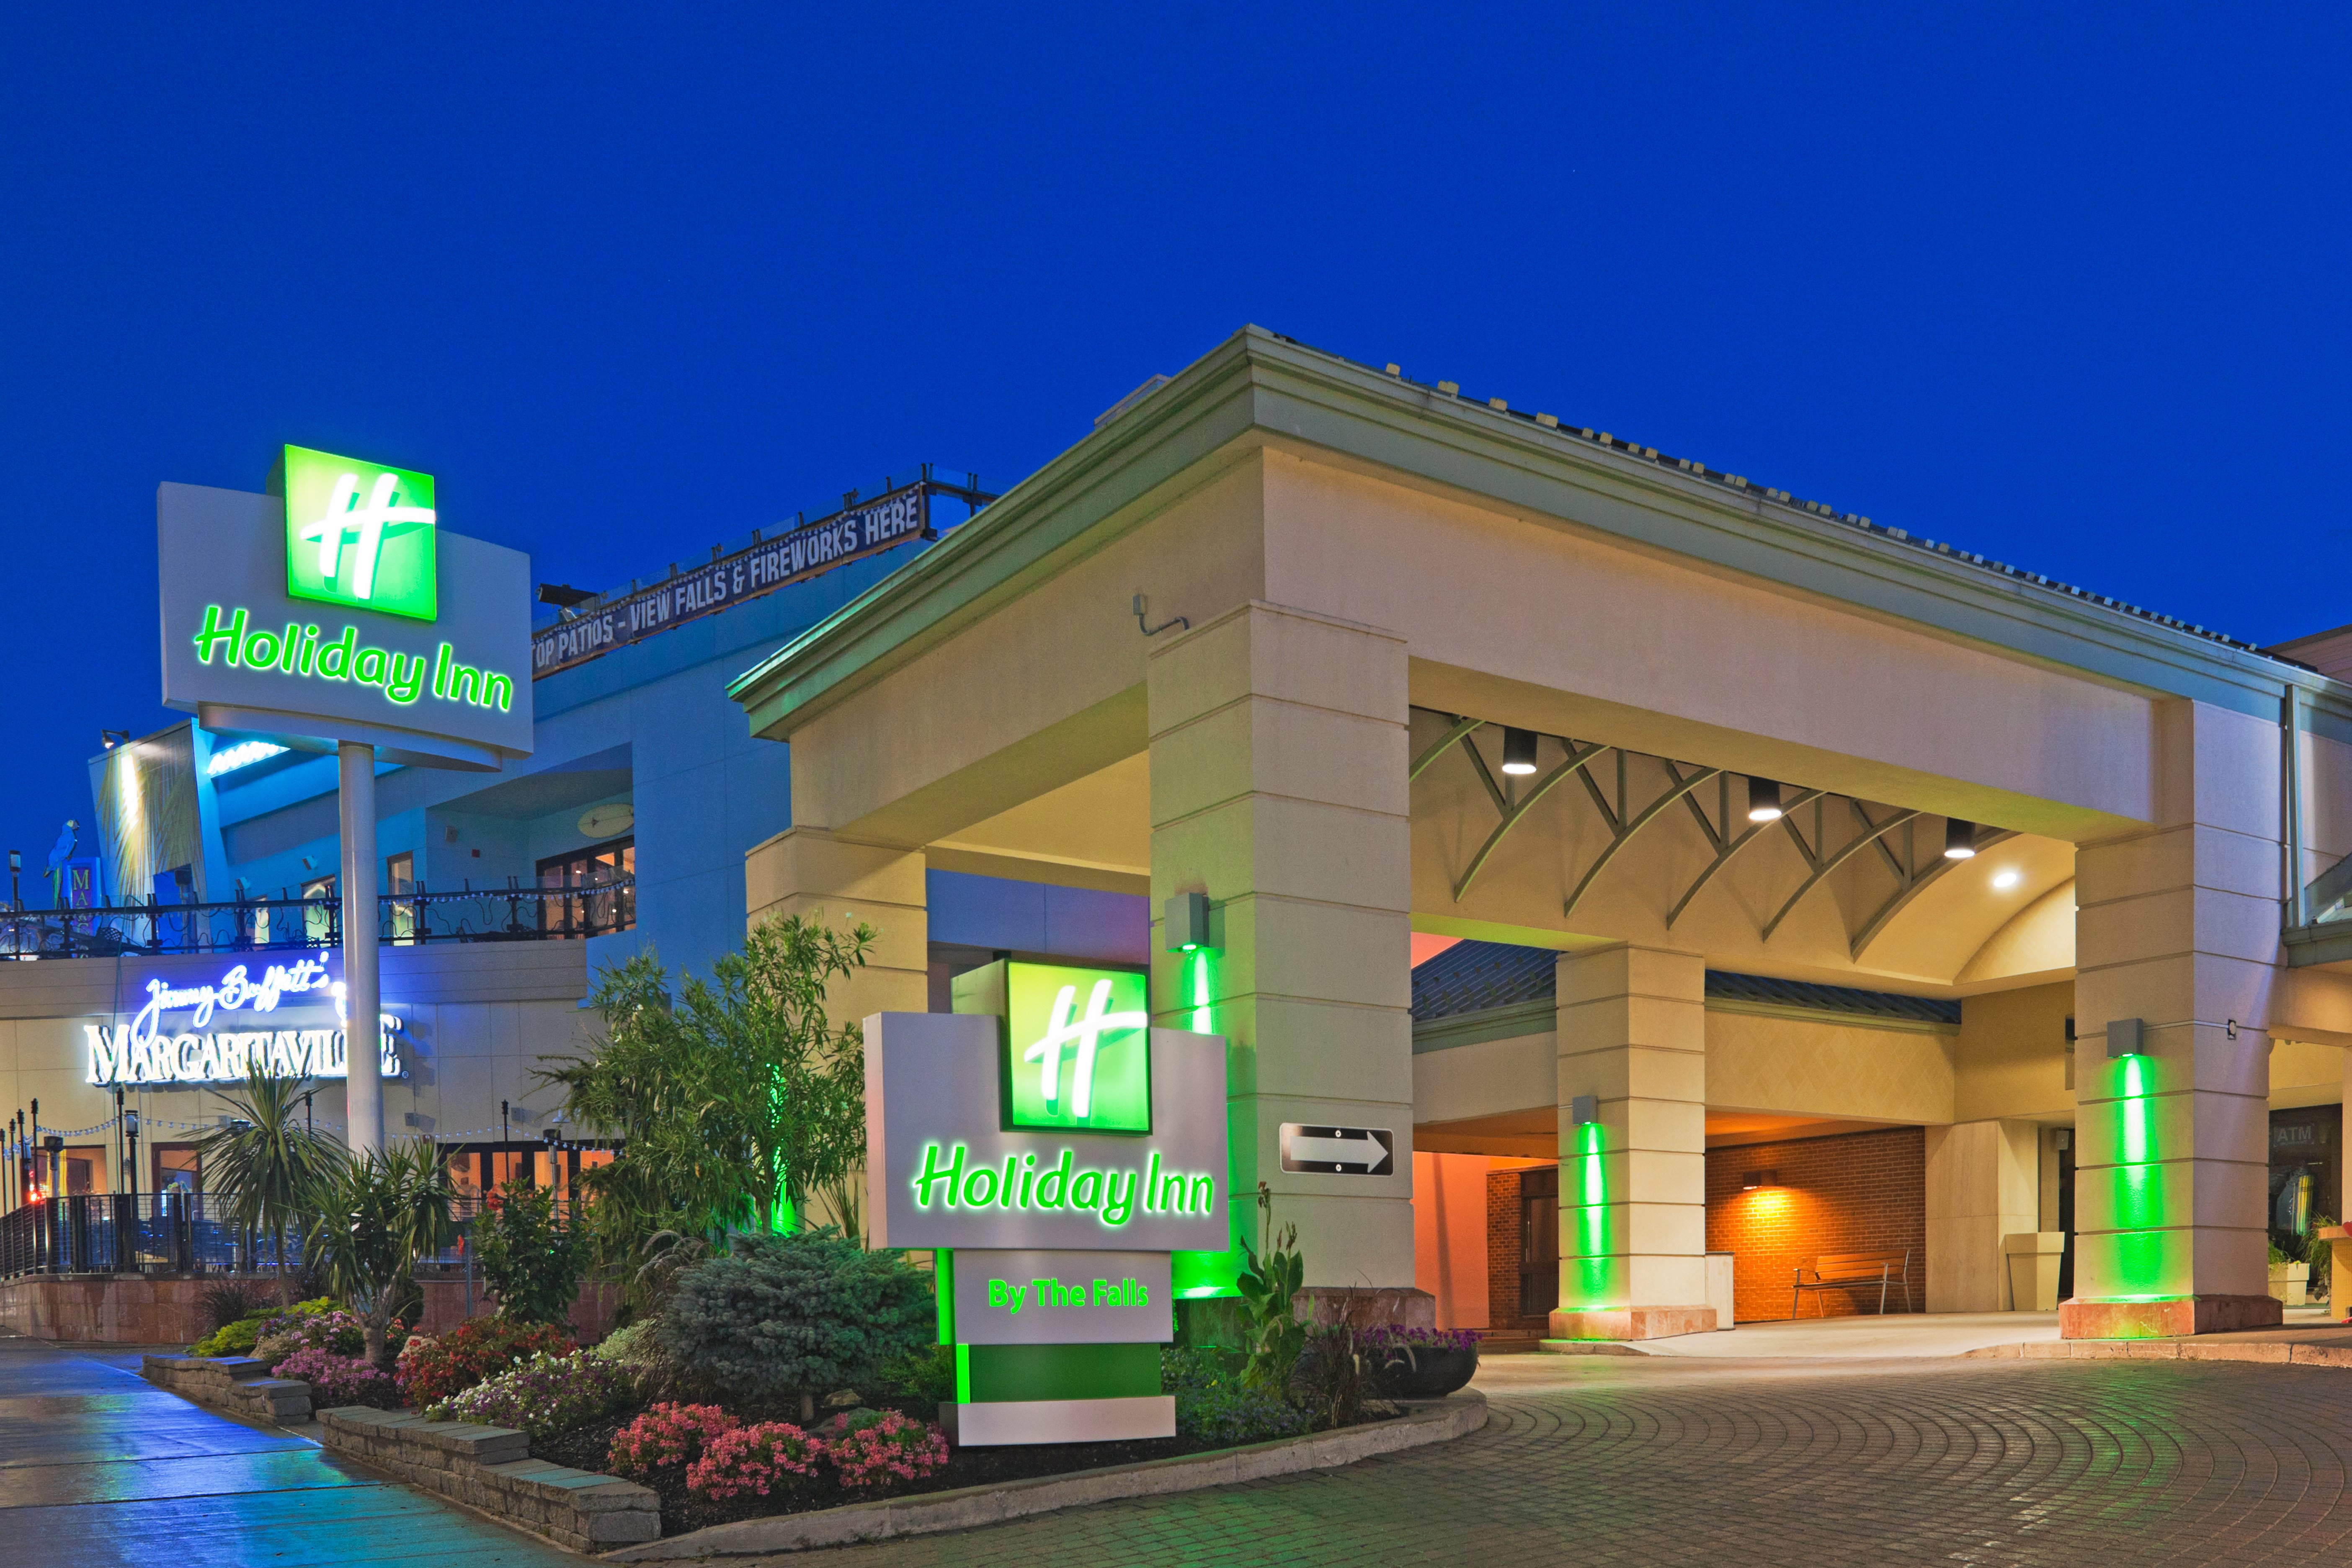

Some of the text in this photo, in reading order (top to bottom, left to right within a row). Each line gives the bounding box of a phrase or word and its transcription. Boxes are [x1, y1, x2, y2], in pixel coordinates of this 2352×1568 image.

[559, 615, 614, 660] PATIOS
[630, 591, 670, 632] VIEW
[676, 570, 727, 615] FALLS
[733, 564, 745, 594] &
[750, 519, 858, 588] FIREWORKS
[865, 495, 918, 545] HERE
[194, 606, 513, 712] Holiday Inn
[130, 951, 329, 1048] Jimmy Buffett's
[2277, 1125, 2311, 1142] ATM
[912, 1144, 1214, 1227] Holiday Inn
[988, 1277, 1148, 1315] By The Falls
